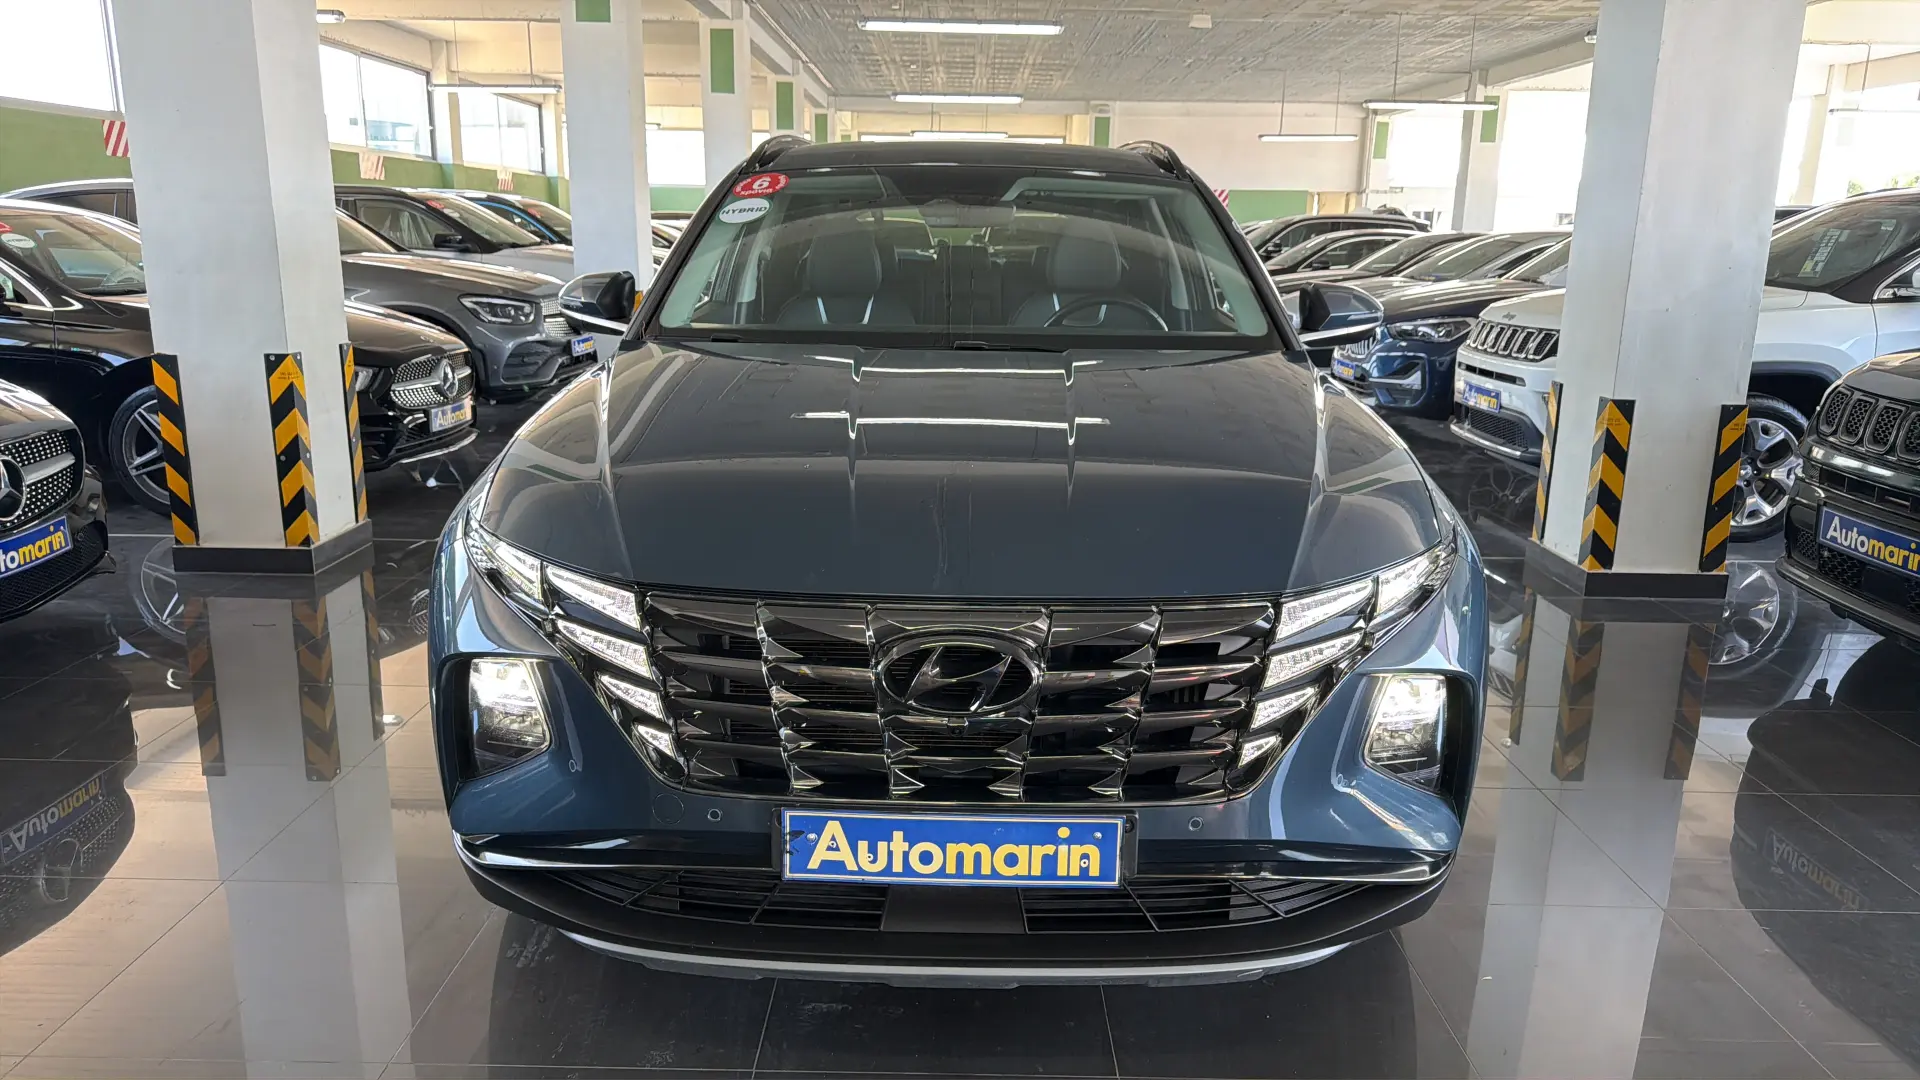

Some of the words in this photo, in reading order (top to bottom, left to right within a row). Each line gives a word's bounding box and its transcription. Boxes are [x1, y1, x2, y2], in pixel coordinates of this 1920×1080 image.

[752, 177, 771, 190] 6
[721, 206, 767, 215] HYBRID
[807, 820, 1101, 877] Automarin
